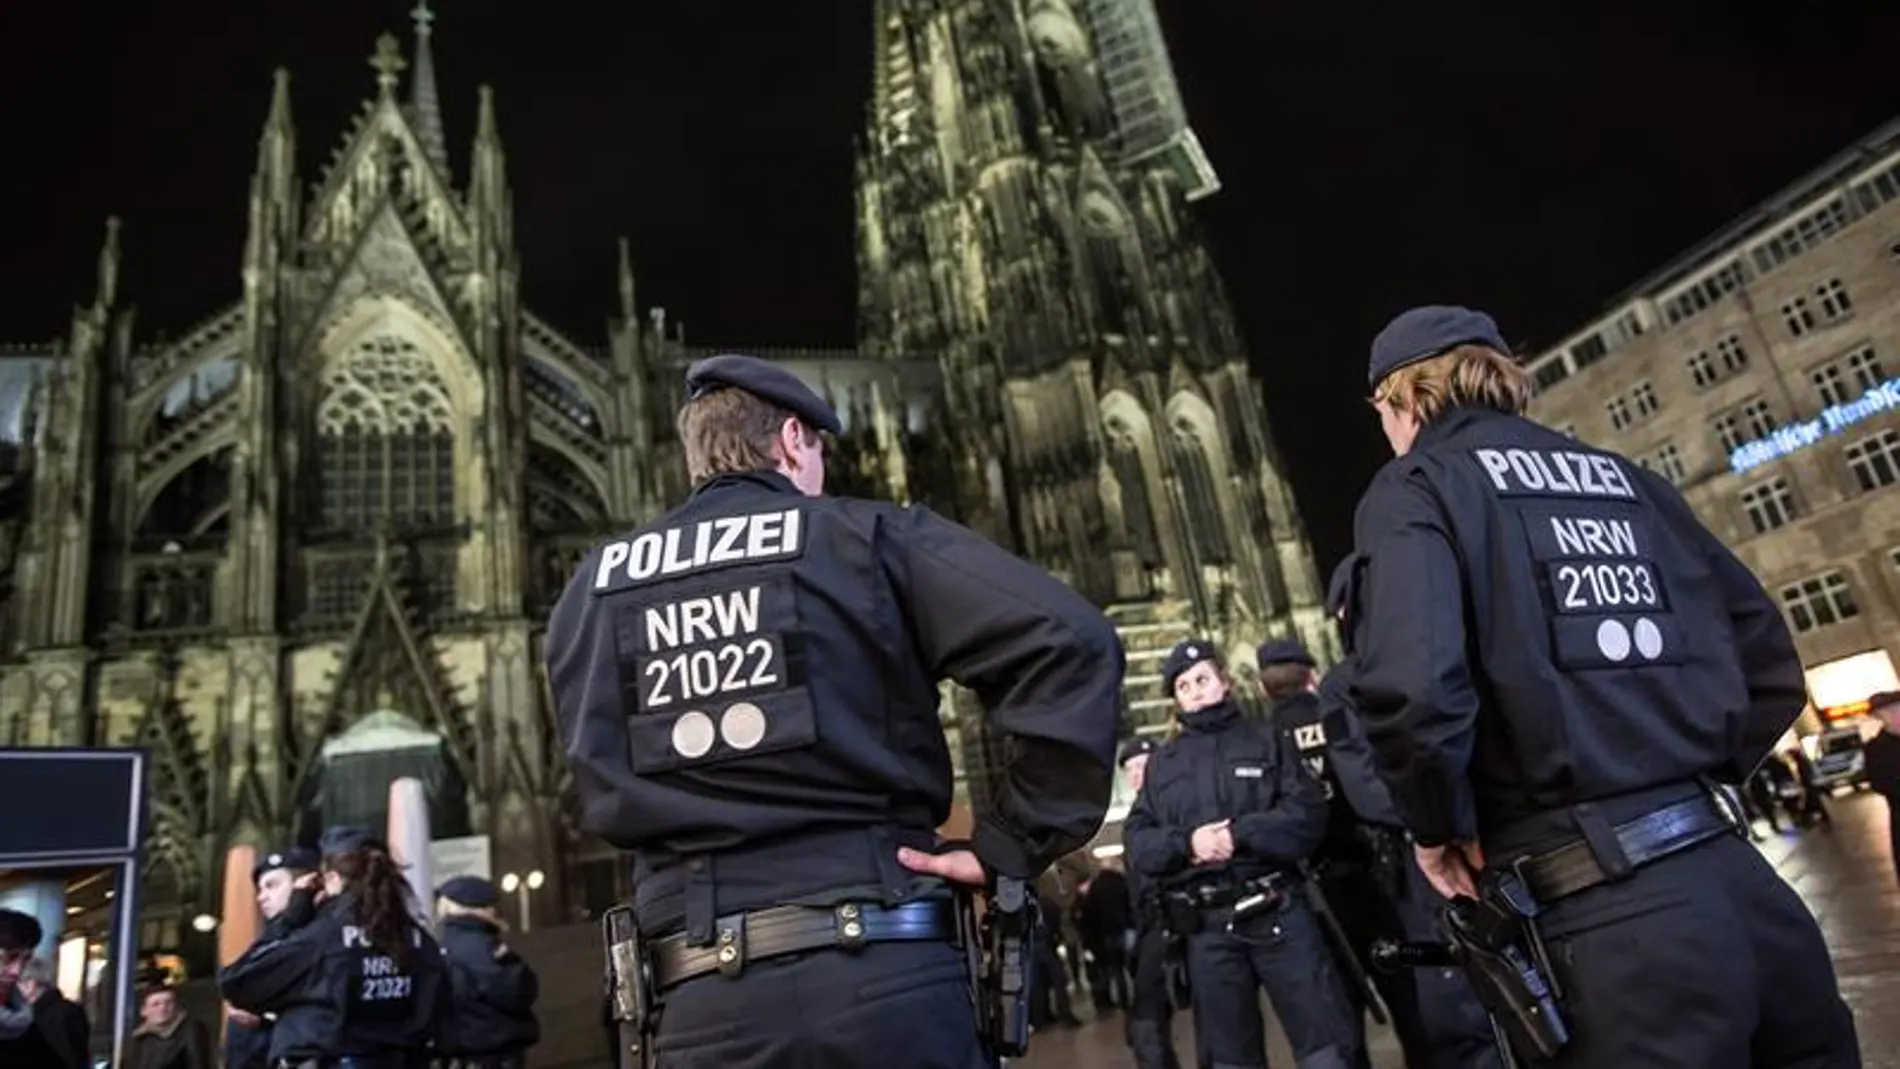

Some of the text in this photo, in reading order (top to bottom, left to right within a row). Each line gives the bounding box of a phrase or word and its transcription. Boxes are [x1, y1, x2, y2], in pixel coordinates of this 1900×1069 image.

[1476, 449, 1636, 498] POLIZEI
[595, 508, 800, 588] POLIZEI
[1550, 516, 1638, 556] NRW
[1558, 564, 1656, 608] 21033
[645, 586, 761, 652] NRW
[645, 638, 777, 706] 21022
[363, 955, 399, 977] NR
